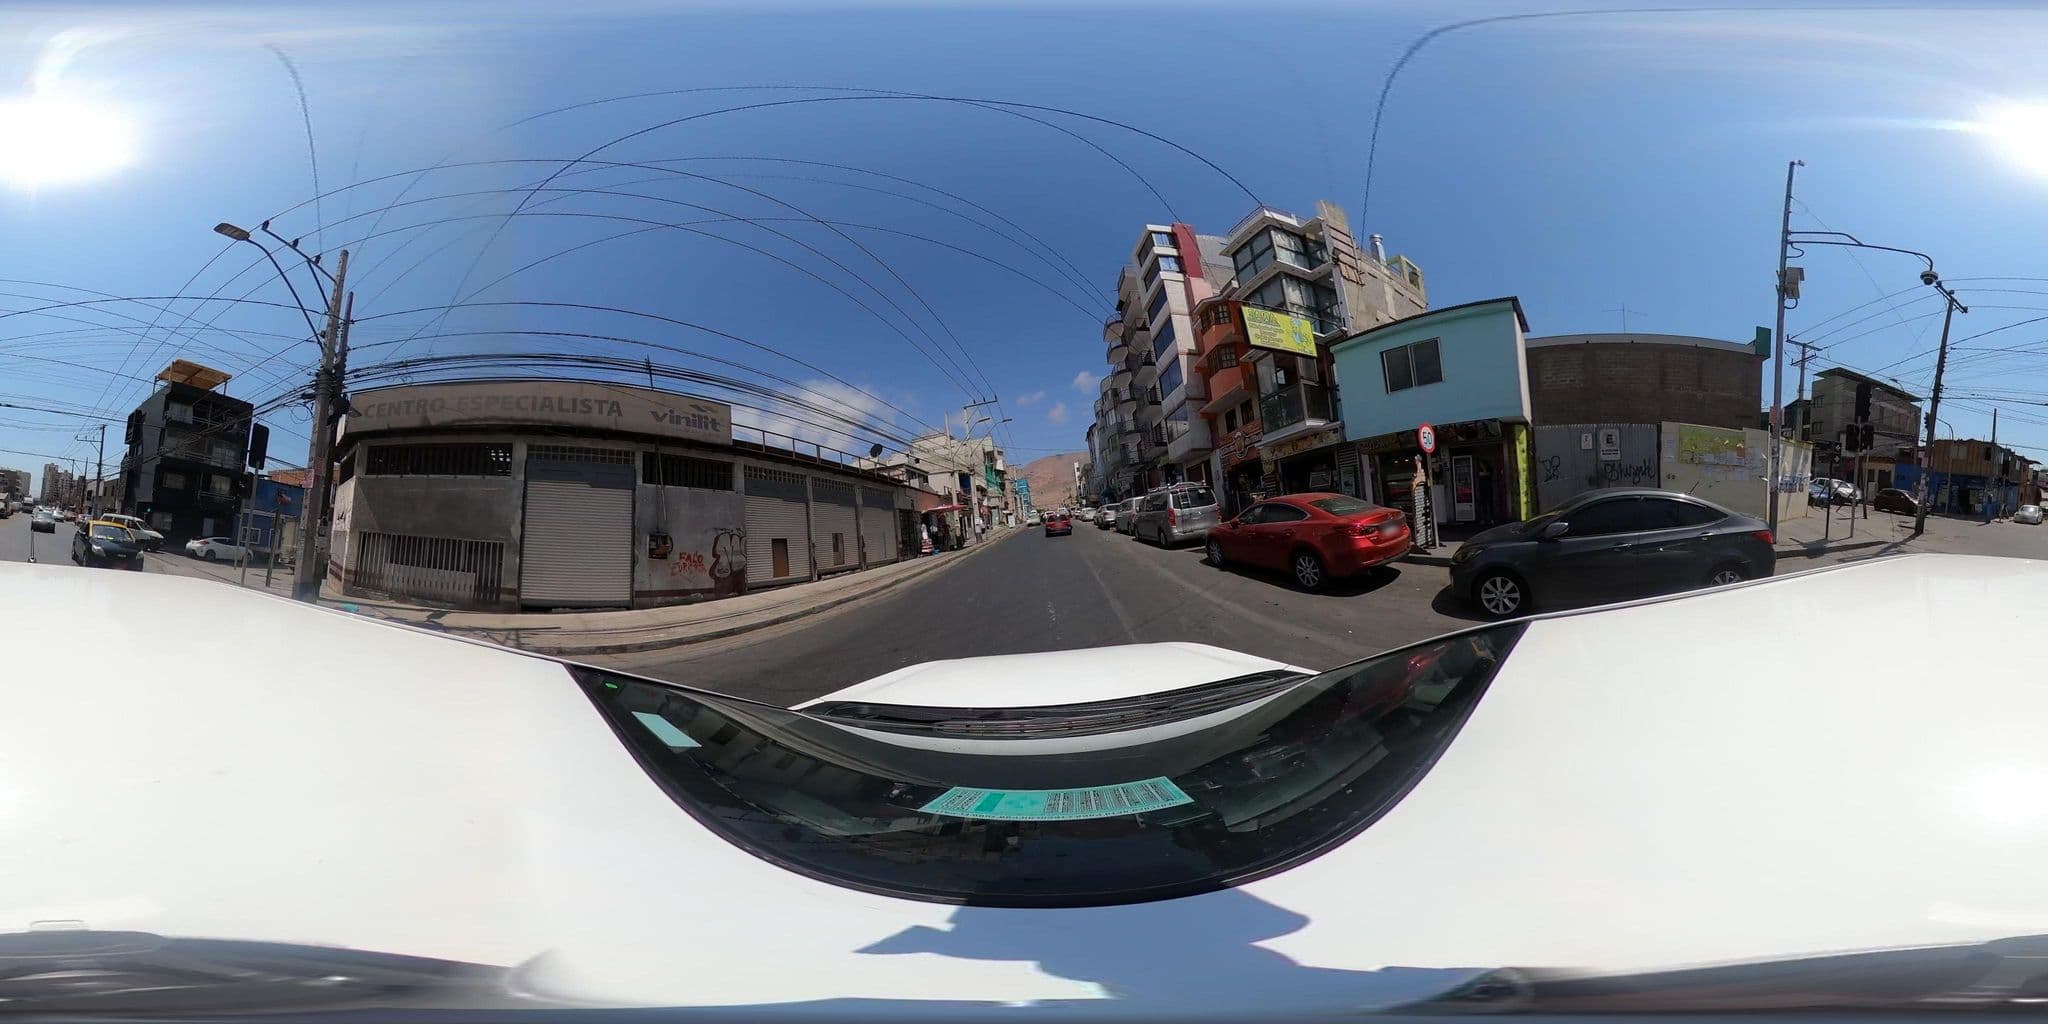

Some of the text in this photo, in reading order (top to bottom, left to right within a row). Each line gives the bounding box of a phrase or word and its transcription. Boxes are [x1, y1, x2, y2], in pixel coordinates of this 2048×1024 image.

[363, 395, 623, 418] CENTRO ESPECIALISTA
[650, 409, 720, 432] vinilit
[1422, 431, 1433, 445] 50
